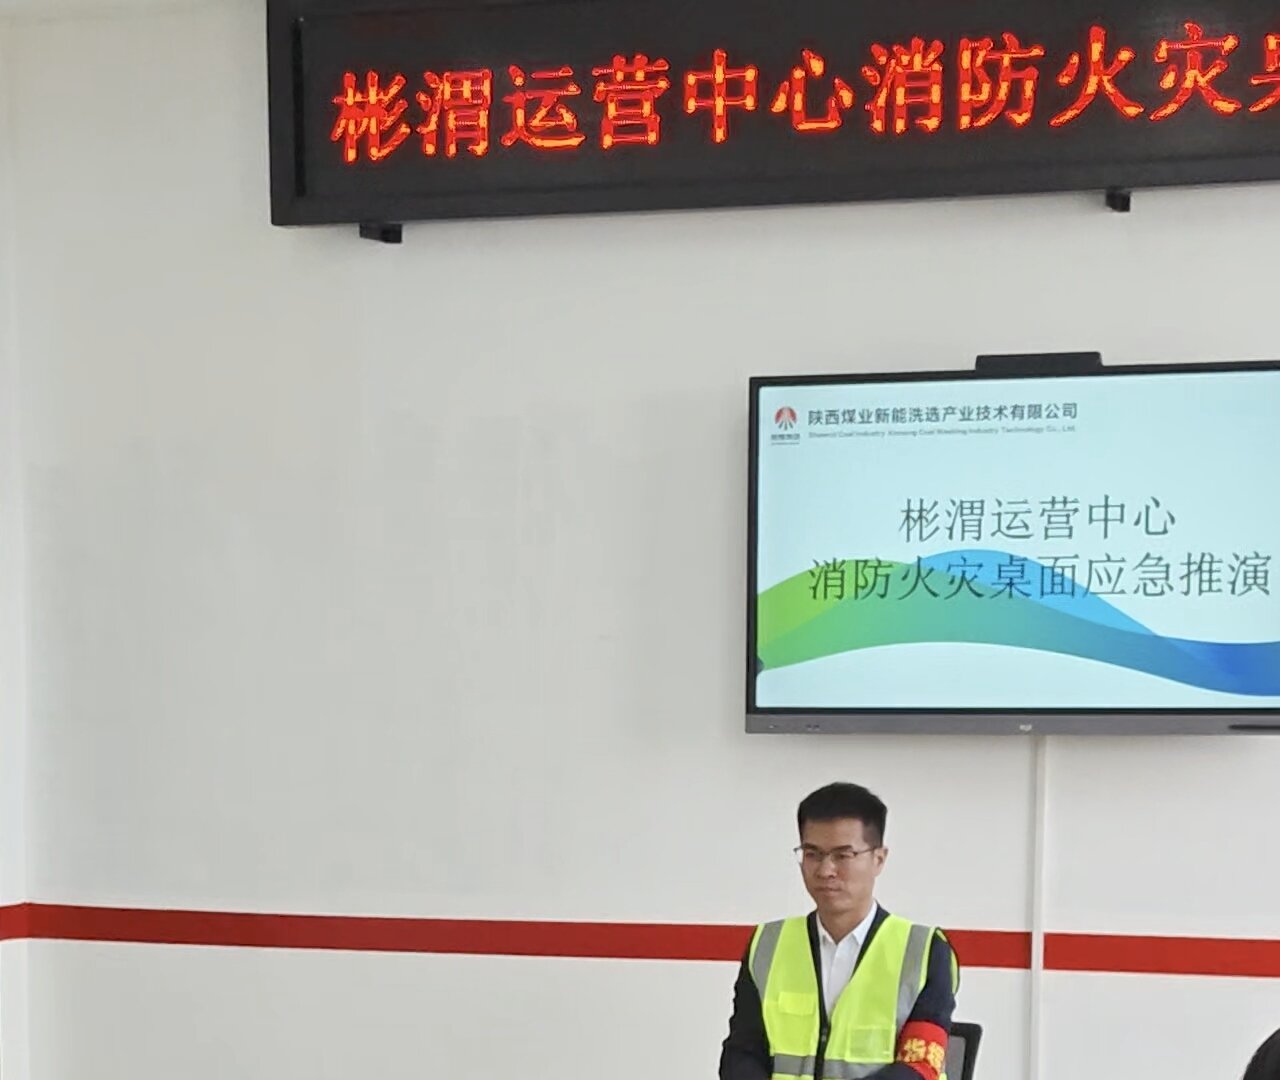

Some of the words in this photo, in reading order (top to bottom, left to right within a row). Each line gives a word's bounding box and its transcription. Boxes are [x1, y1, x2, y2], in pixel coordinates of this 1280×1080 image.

[808, 403, 1077, 425] 陕西煤业新能洗选产业技术有限公司
[898, 494, 1176, 543] 彬渭运营中心
[808, 551, 1272, 600] 消防火灾桌面应急推演
